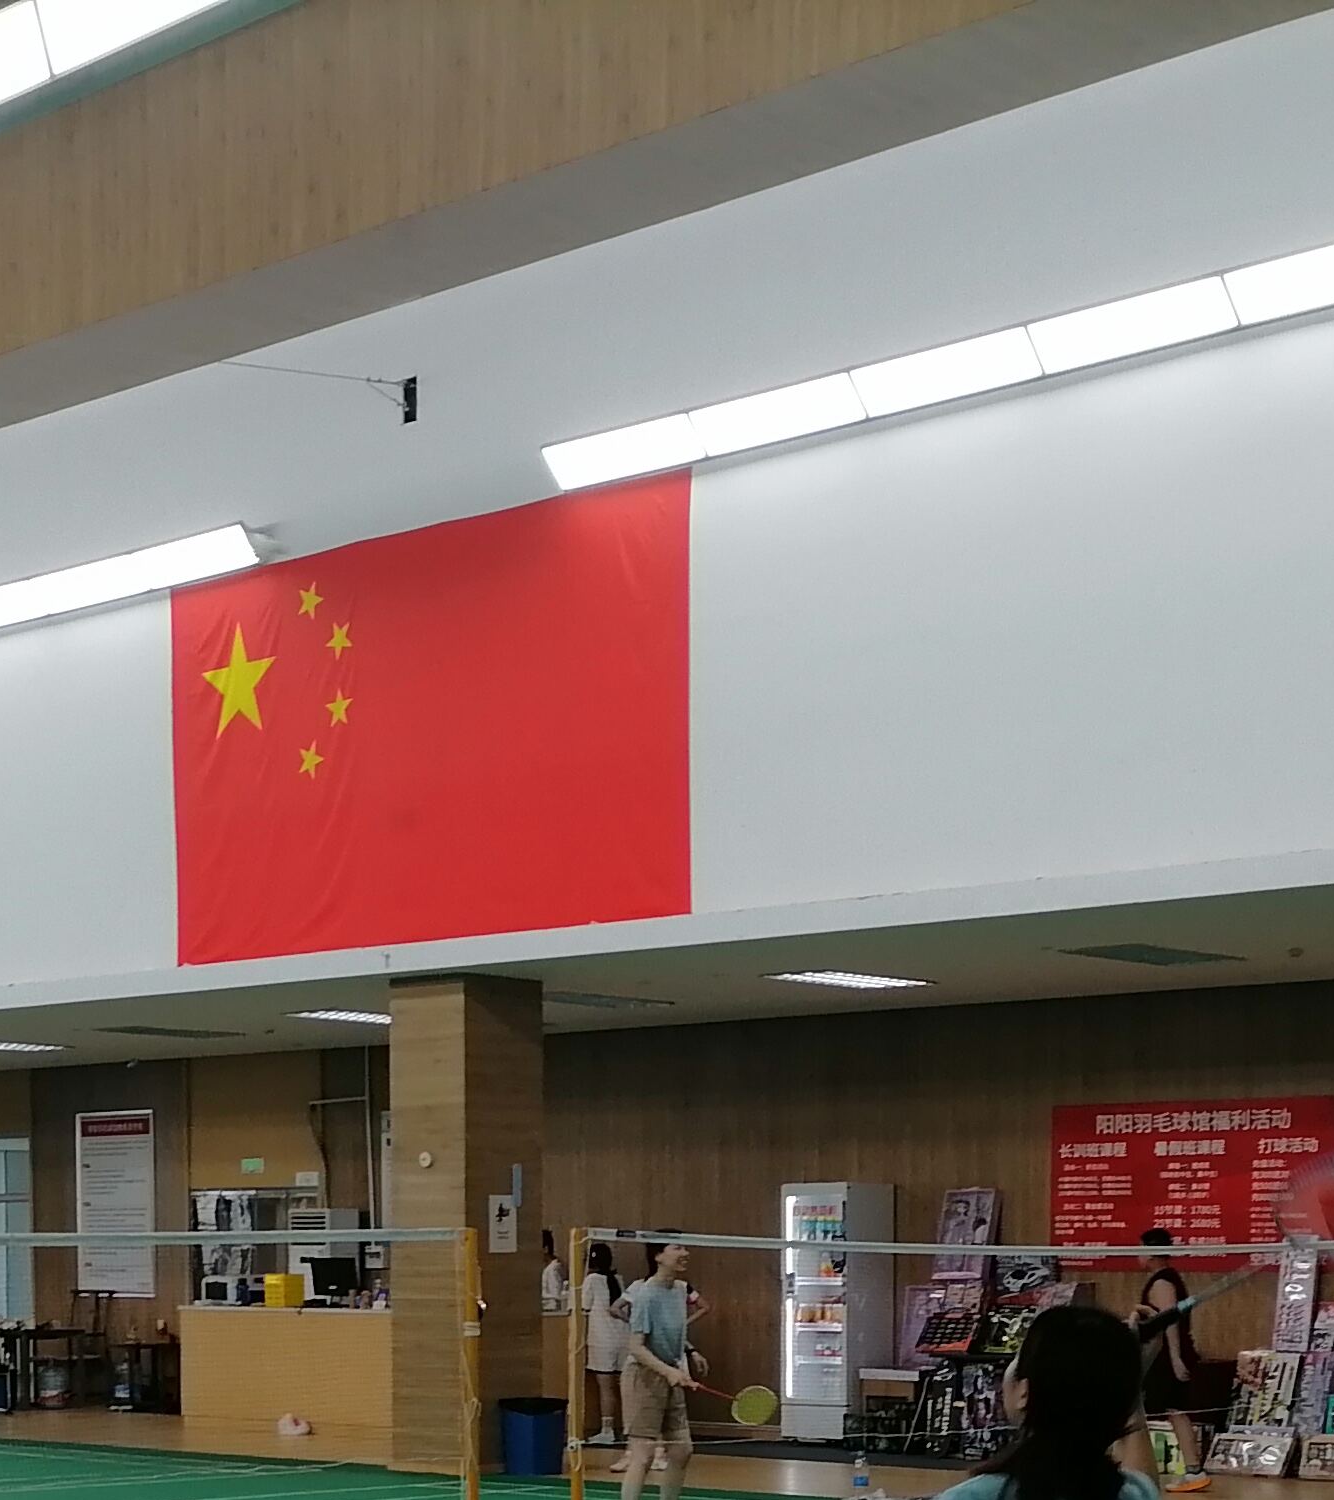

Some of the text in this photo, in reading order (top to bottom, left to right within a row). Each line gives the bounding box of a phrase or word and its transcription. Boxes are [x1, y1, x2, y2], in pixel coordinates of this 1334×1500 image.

[1096, 1109, 1292, 1135] 阳阳羽毛球馆福利活动
[1257, 1137, 1319, 1154] 打球活动
